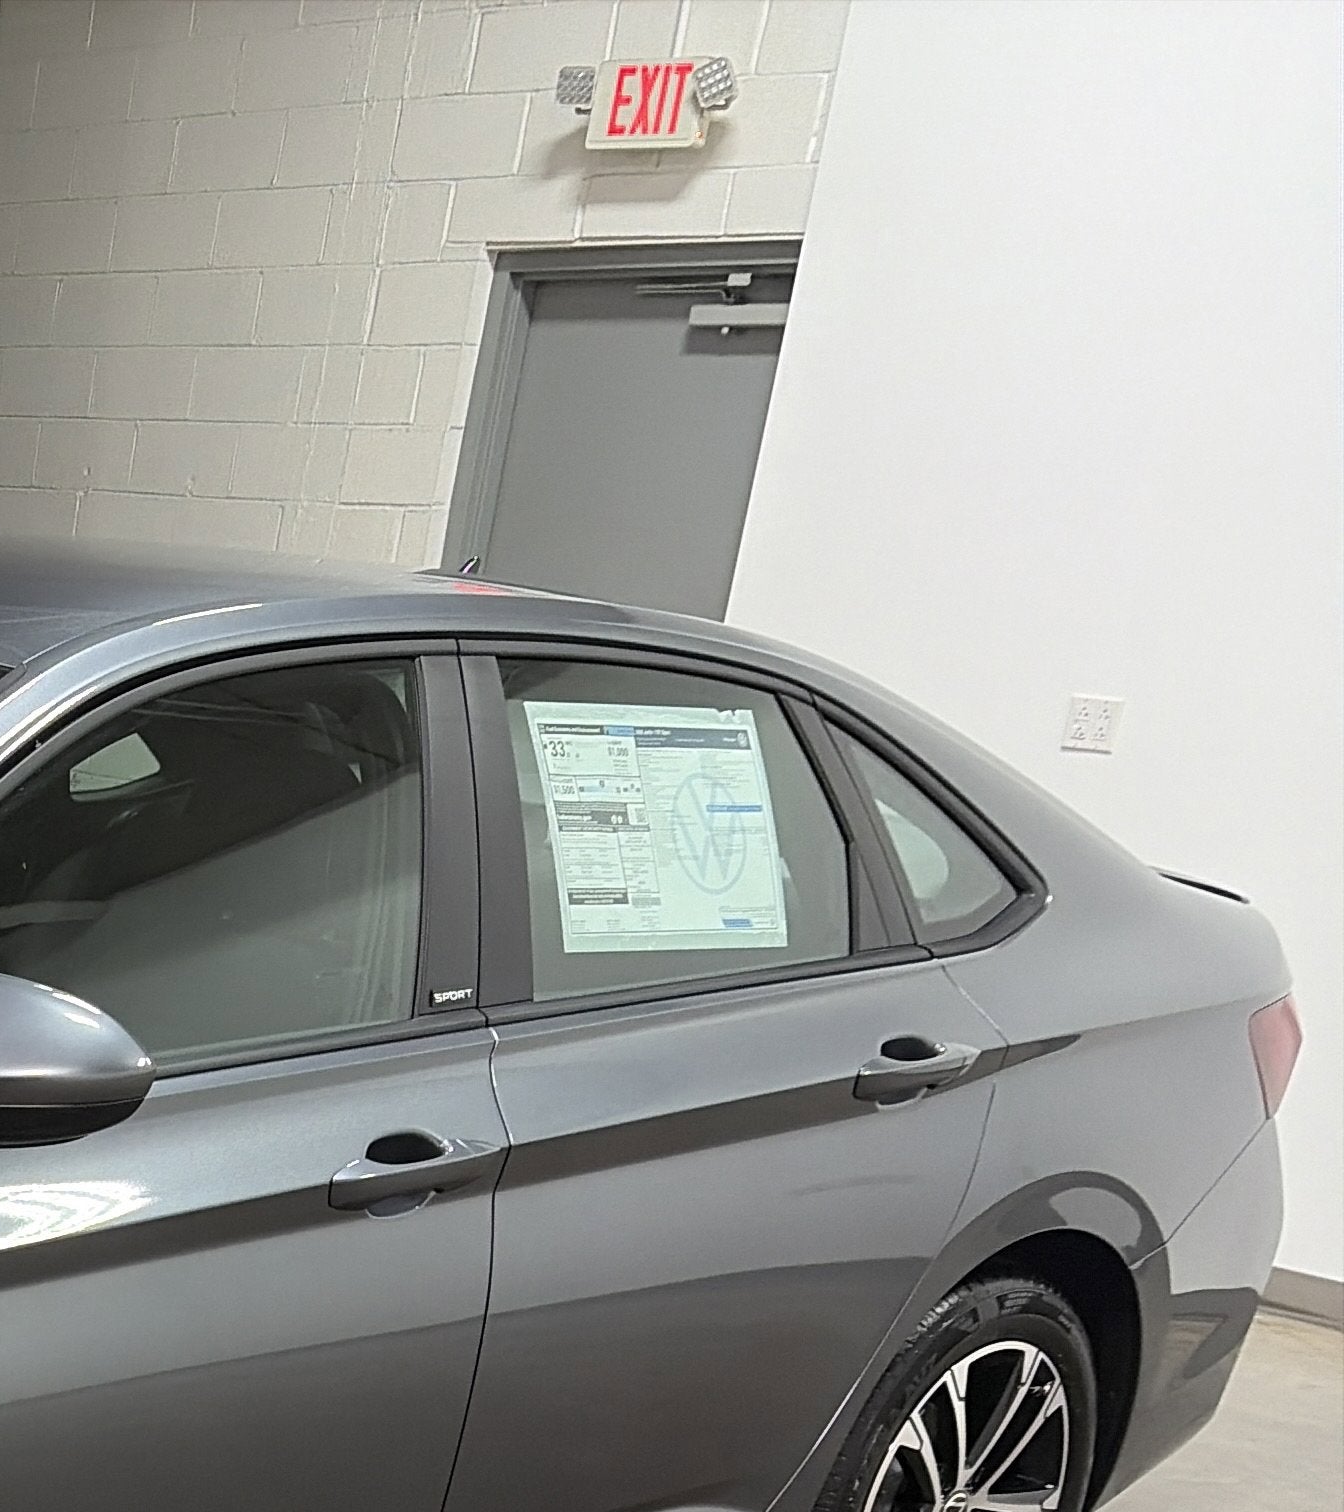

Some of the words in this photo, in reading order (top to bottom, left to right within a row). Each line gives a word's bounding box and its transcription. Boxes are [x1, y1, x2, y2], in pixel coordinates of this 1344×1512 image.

[606, 62, 694, 136] EXIT
[548, 740, 566, 757] 33
[433, 988, 473, 1004] SPORT
